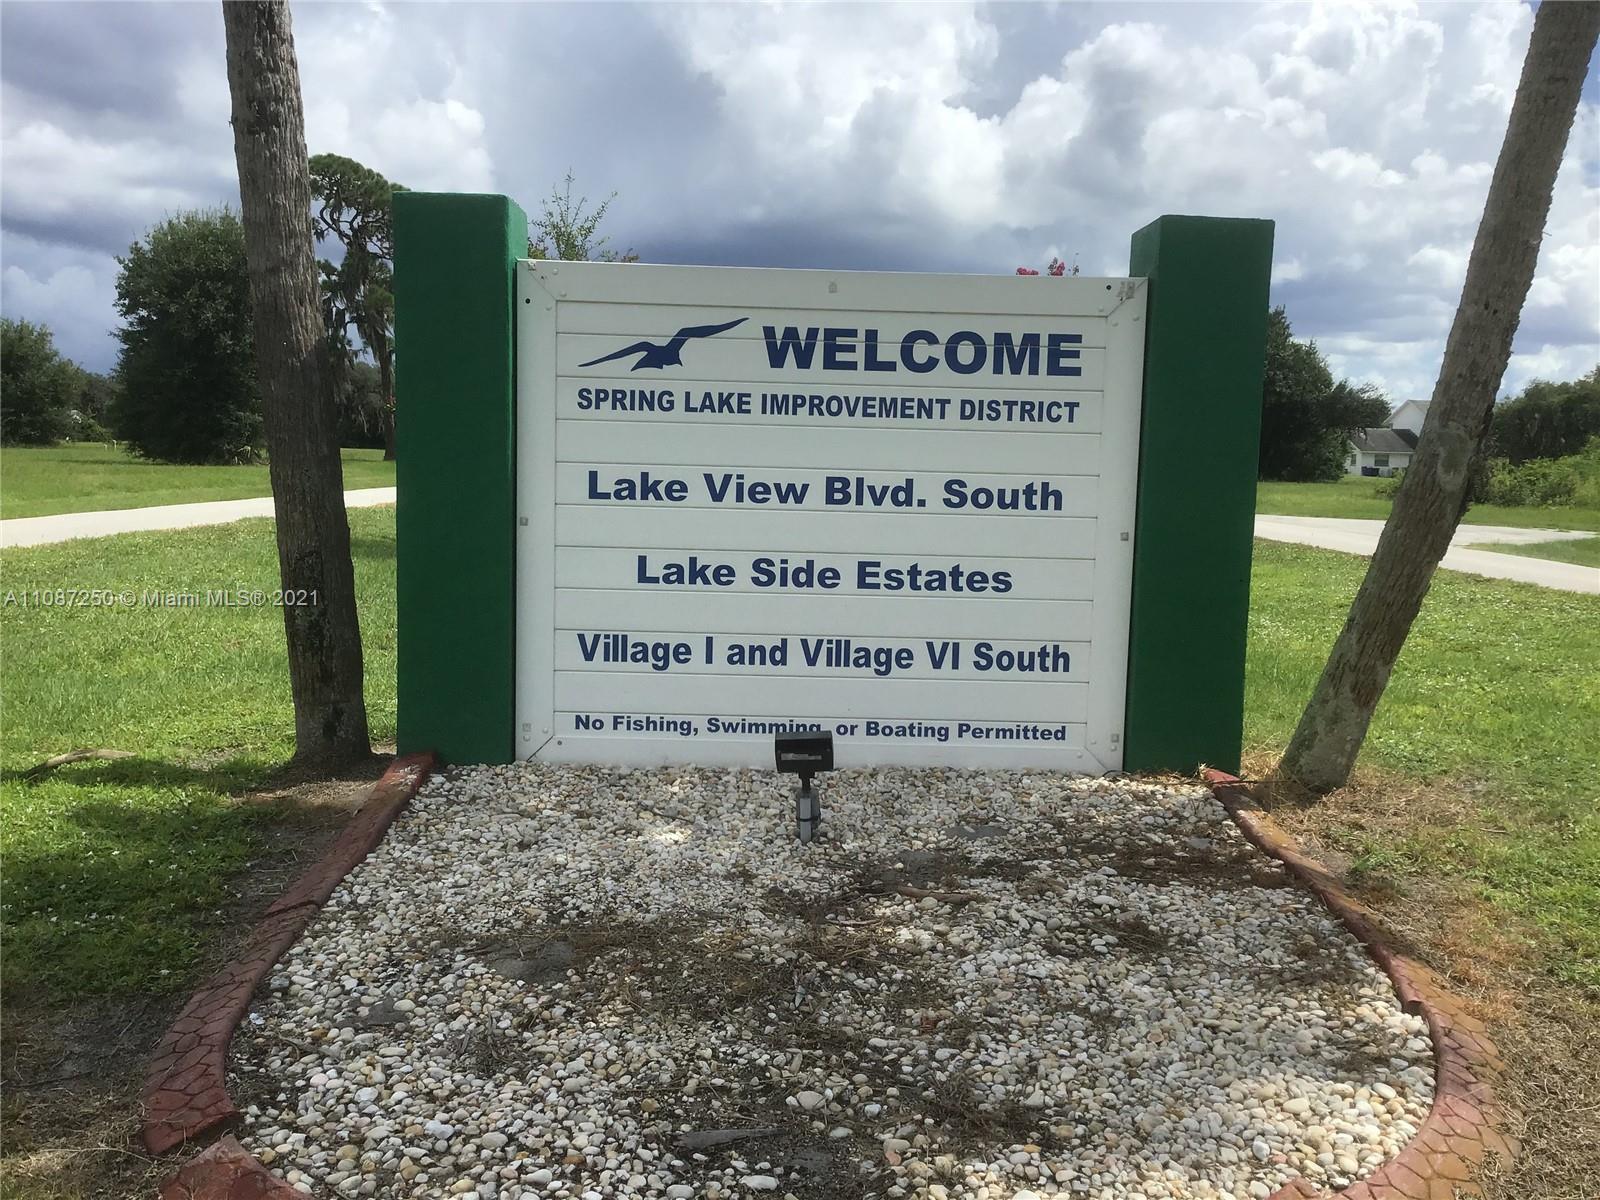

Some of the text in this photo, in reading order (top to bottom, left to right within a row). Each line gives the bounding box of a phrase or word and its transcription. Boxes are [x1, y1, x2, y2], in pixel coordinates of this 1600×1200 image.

[762, 325, 1083, 377] WELCOME
[577, 387, 1081, 424] SPRING LAKE IMPROVEMENT DISTRICT
[588, 470, 1064, 512] Lake View Blvd. South
[637, 554, 1014, 594] Lake Side Estates
[577, 633, 1071, 677] Village I and Village VI South
[574, 714, 605, 731] No
[612, 715, 699, 736] Fishing,
[835, 723, 858, 736] or
[865, 721, 950, 742] Boating
[957, 723, 1067, 741] Permitted
